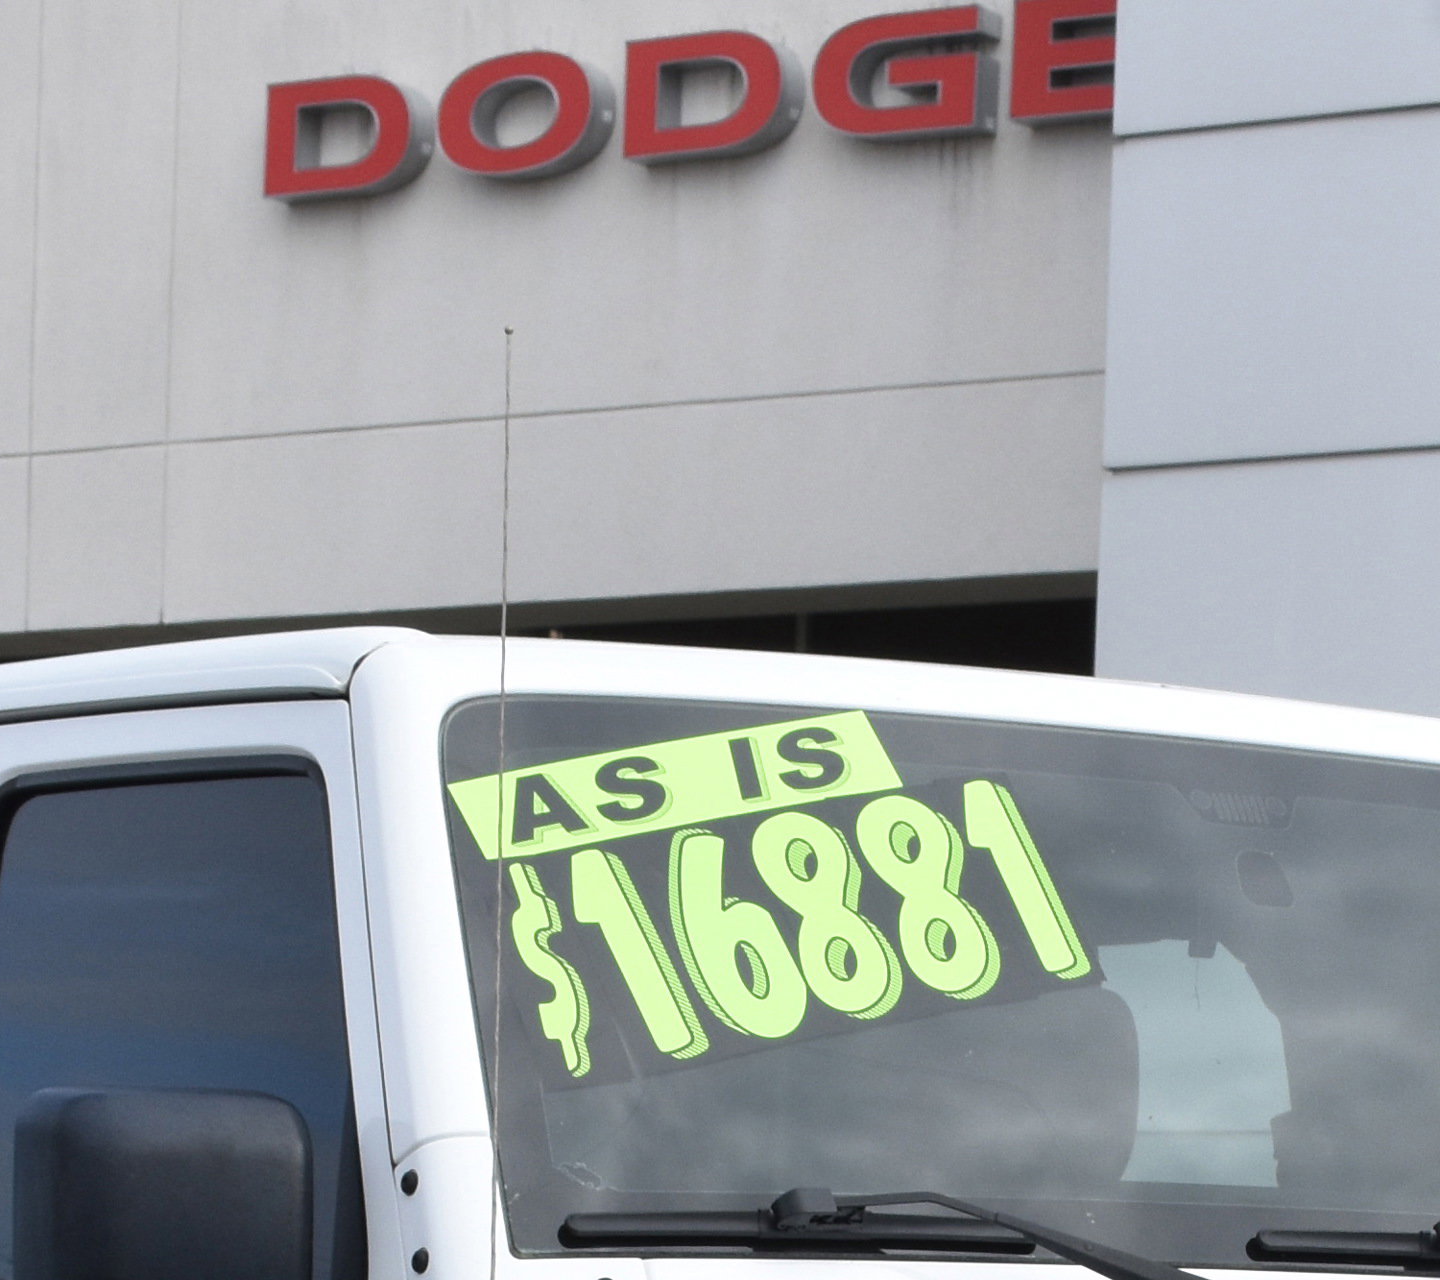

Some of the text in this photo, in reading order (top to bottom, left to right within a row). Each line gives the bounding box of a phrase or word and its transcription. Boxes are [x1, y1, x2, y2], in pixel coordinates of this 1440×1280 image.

[263, 0, 1116, 203] DODGE
[510, 726, 851, 847] AS IS
[508, 779, 1092, 1078] $16881
